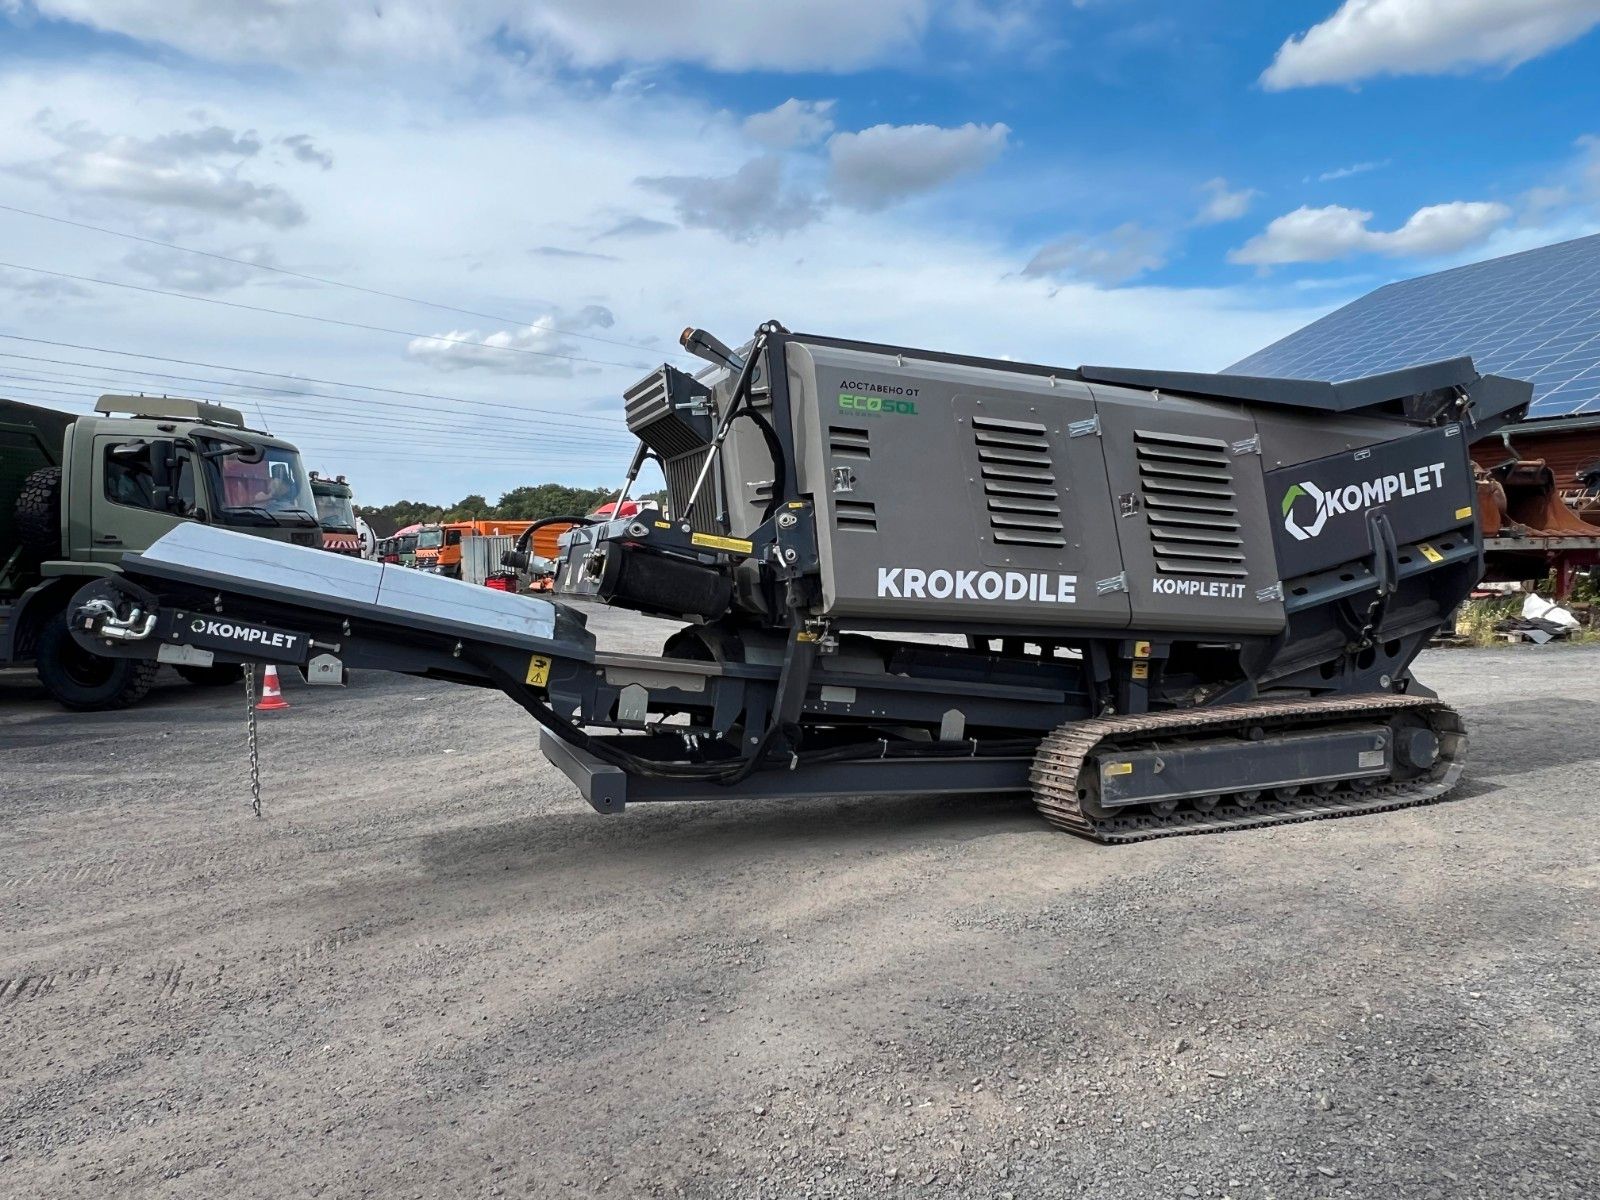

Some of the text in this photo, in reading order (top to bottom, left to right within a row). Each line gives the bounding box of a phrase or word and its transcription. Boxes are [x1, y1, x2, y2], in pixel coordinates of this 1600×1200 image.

[840, 381, 920, 397] ДОСТАВЕНО ОТ
[839, 394, 918, 415] ECOSOL
[1324, 462, 1445, 517] KOMPLET
[877, 567, 1077, 603] KROKODILE
[1152, 578, 1246, 598] KOMPLET.IT
[206, 621, 297, 649] KOMPLET
